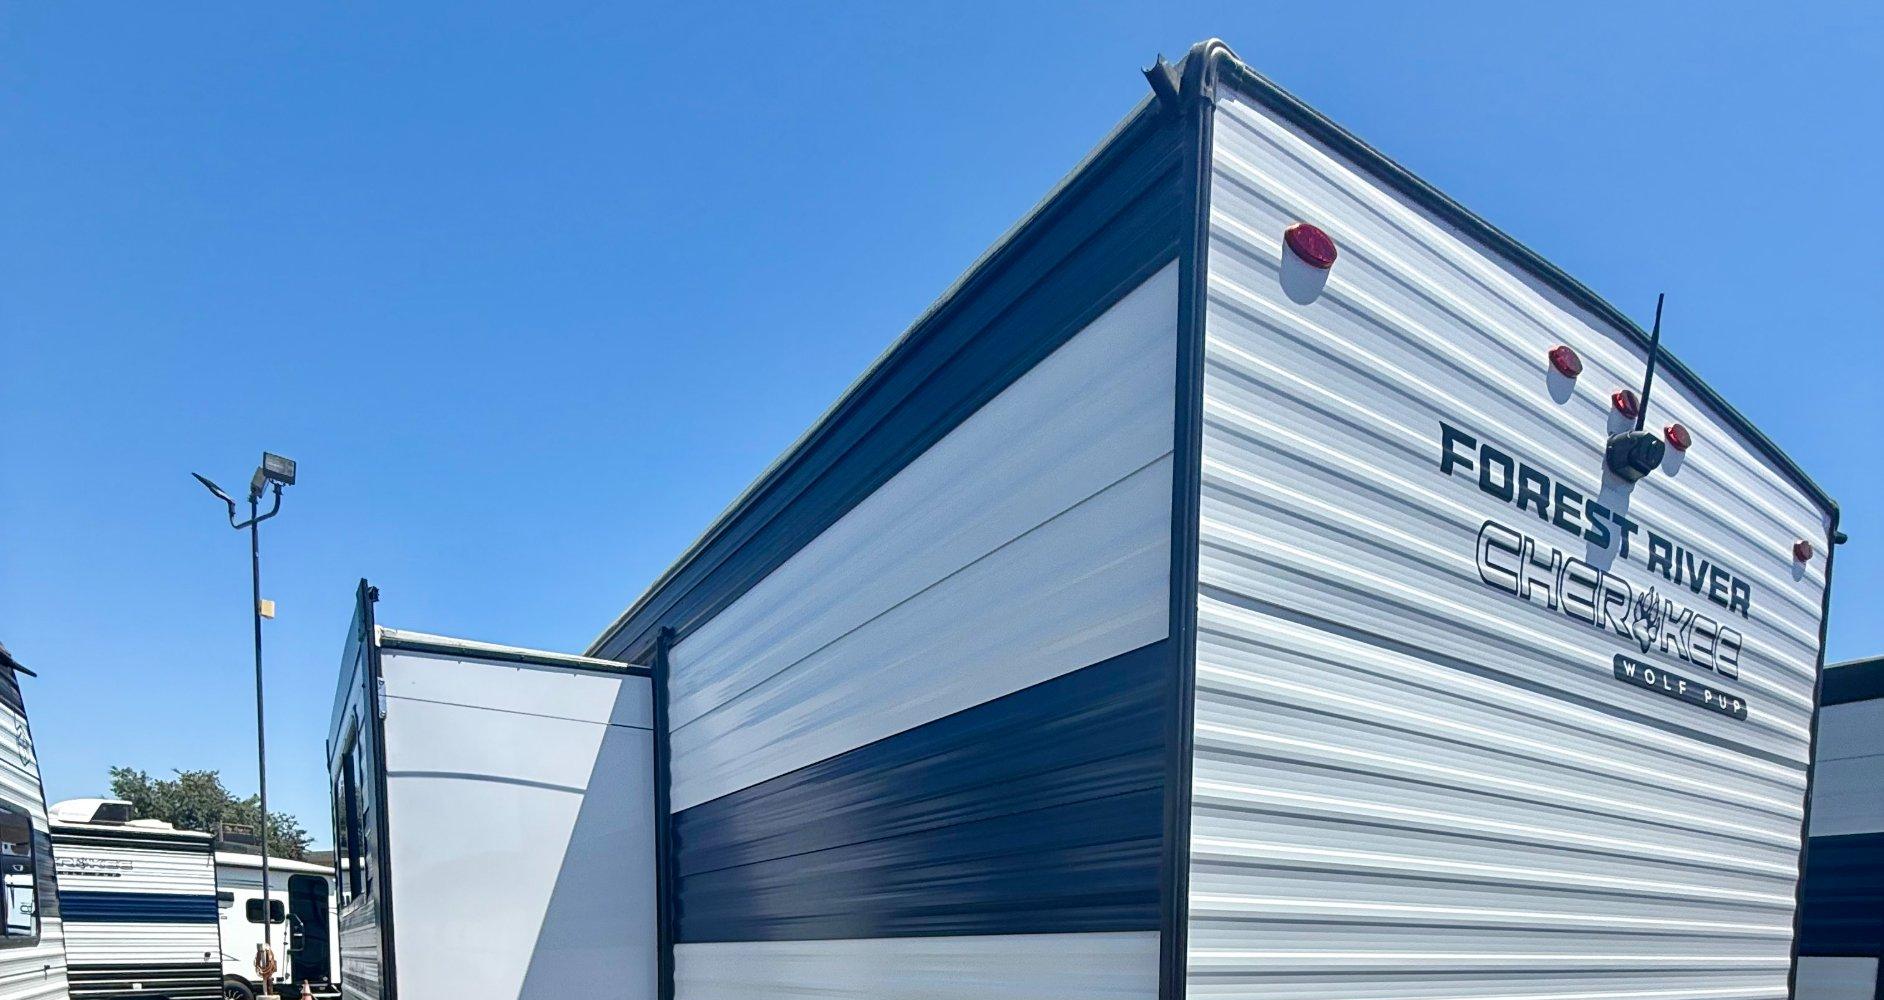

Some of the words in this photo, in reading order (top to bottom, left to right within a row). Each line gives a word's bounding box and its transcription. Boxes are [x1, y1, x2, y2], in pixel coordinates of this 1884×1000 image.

[1439, 420, 1638, 560] FOREST
[1647, 531, 1751, 619] RIVER
[1476, 519, 1742, 681] CHEROKEE
[1623, 660, 1687, 695] WOLF
[1704, 689, 1741, 713] PUP
